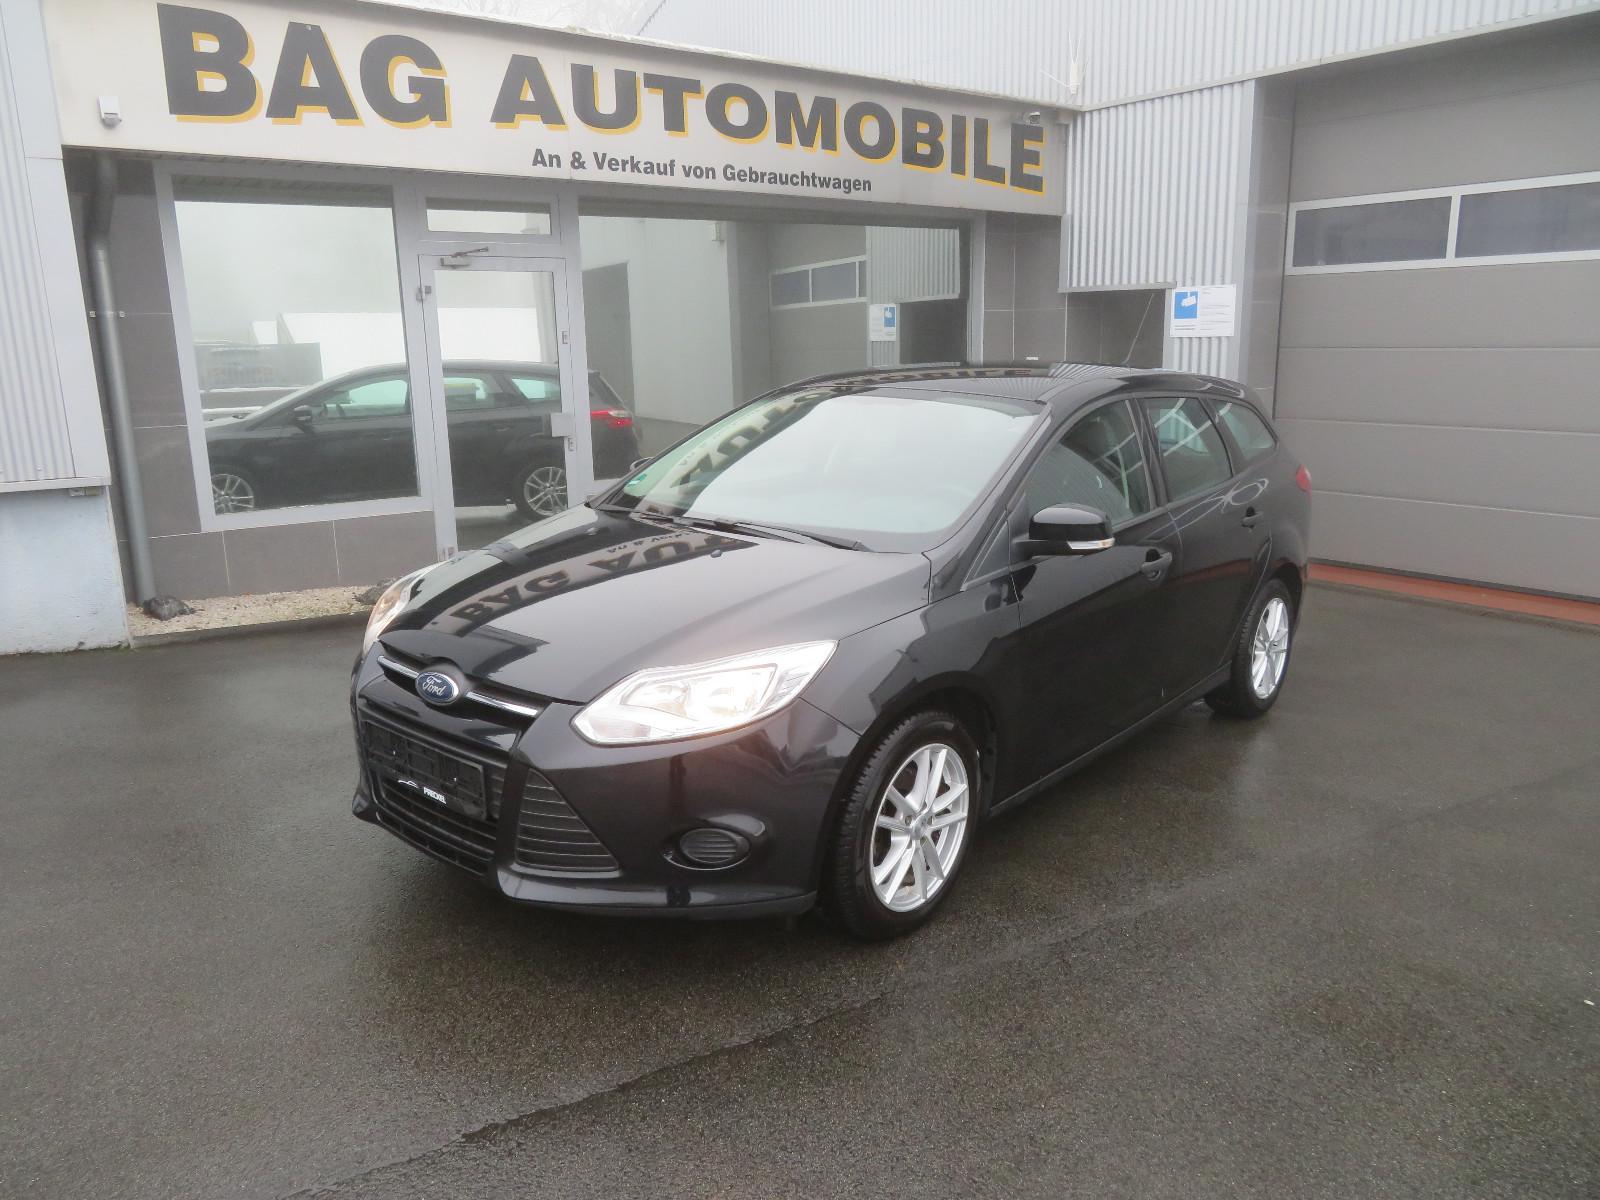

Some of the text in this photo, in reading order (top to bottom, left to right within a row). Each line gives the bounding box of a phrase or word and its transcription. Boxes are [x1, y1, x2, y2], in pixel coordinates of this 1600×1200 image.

[157, 2, 1046, 196] BAG AUTOMOBILE
[531, 148, 872, 194] An & Verkauf von Gebrauchtwagen
[422, 675, 447, 697] Ford
